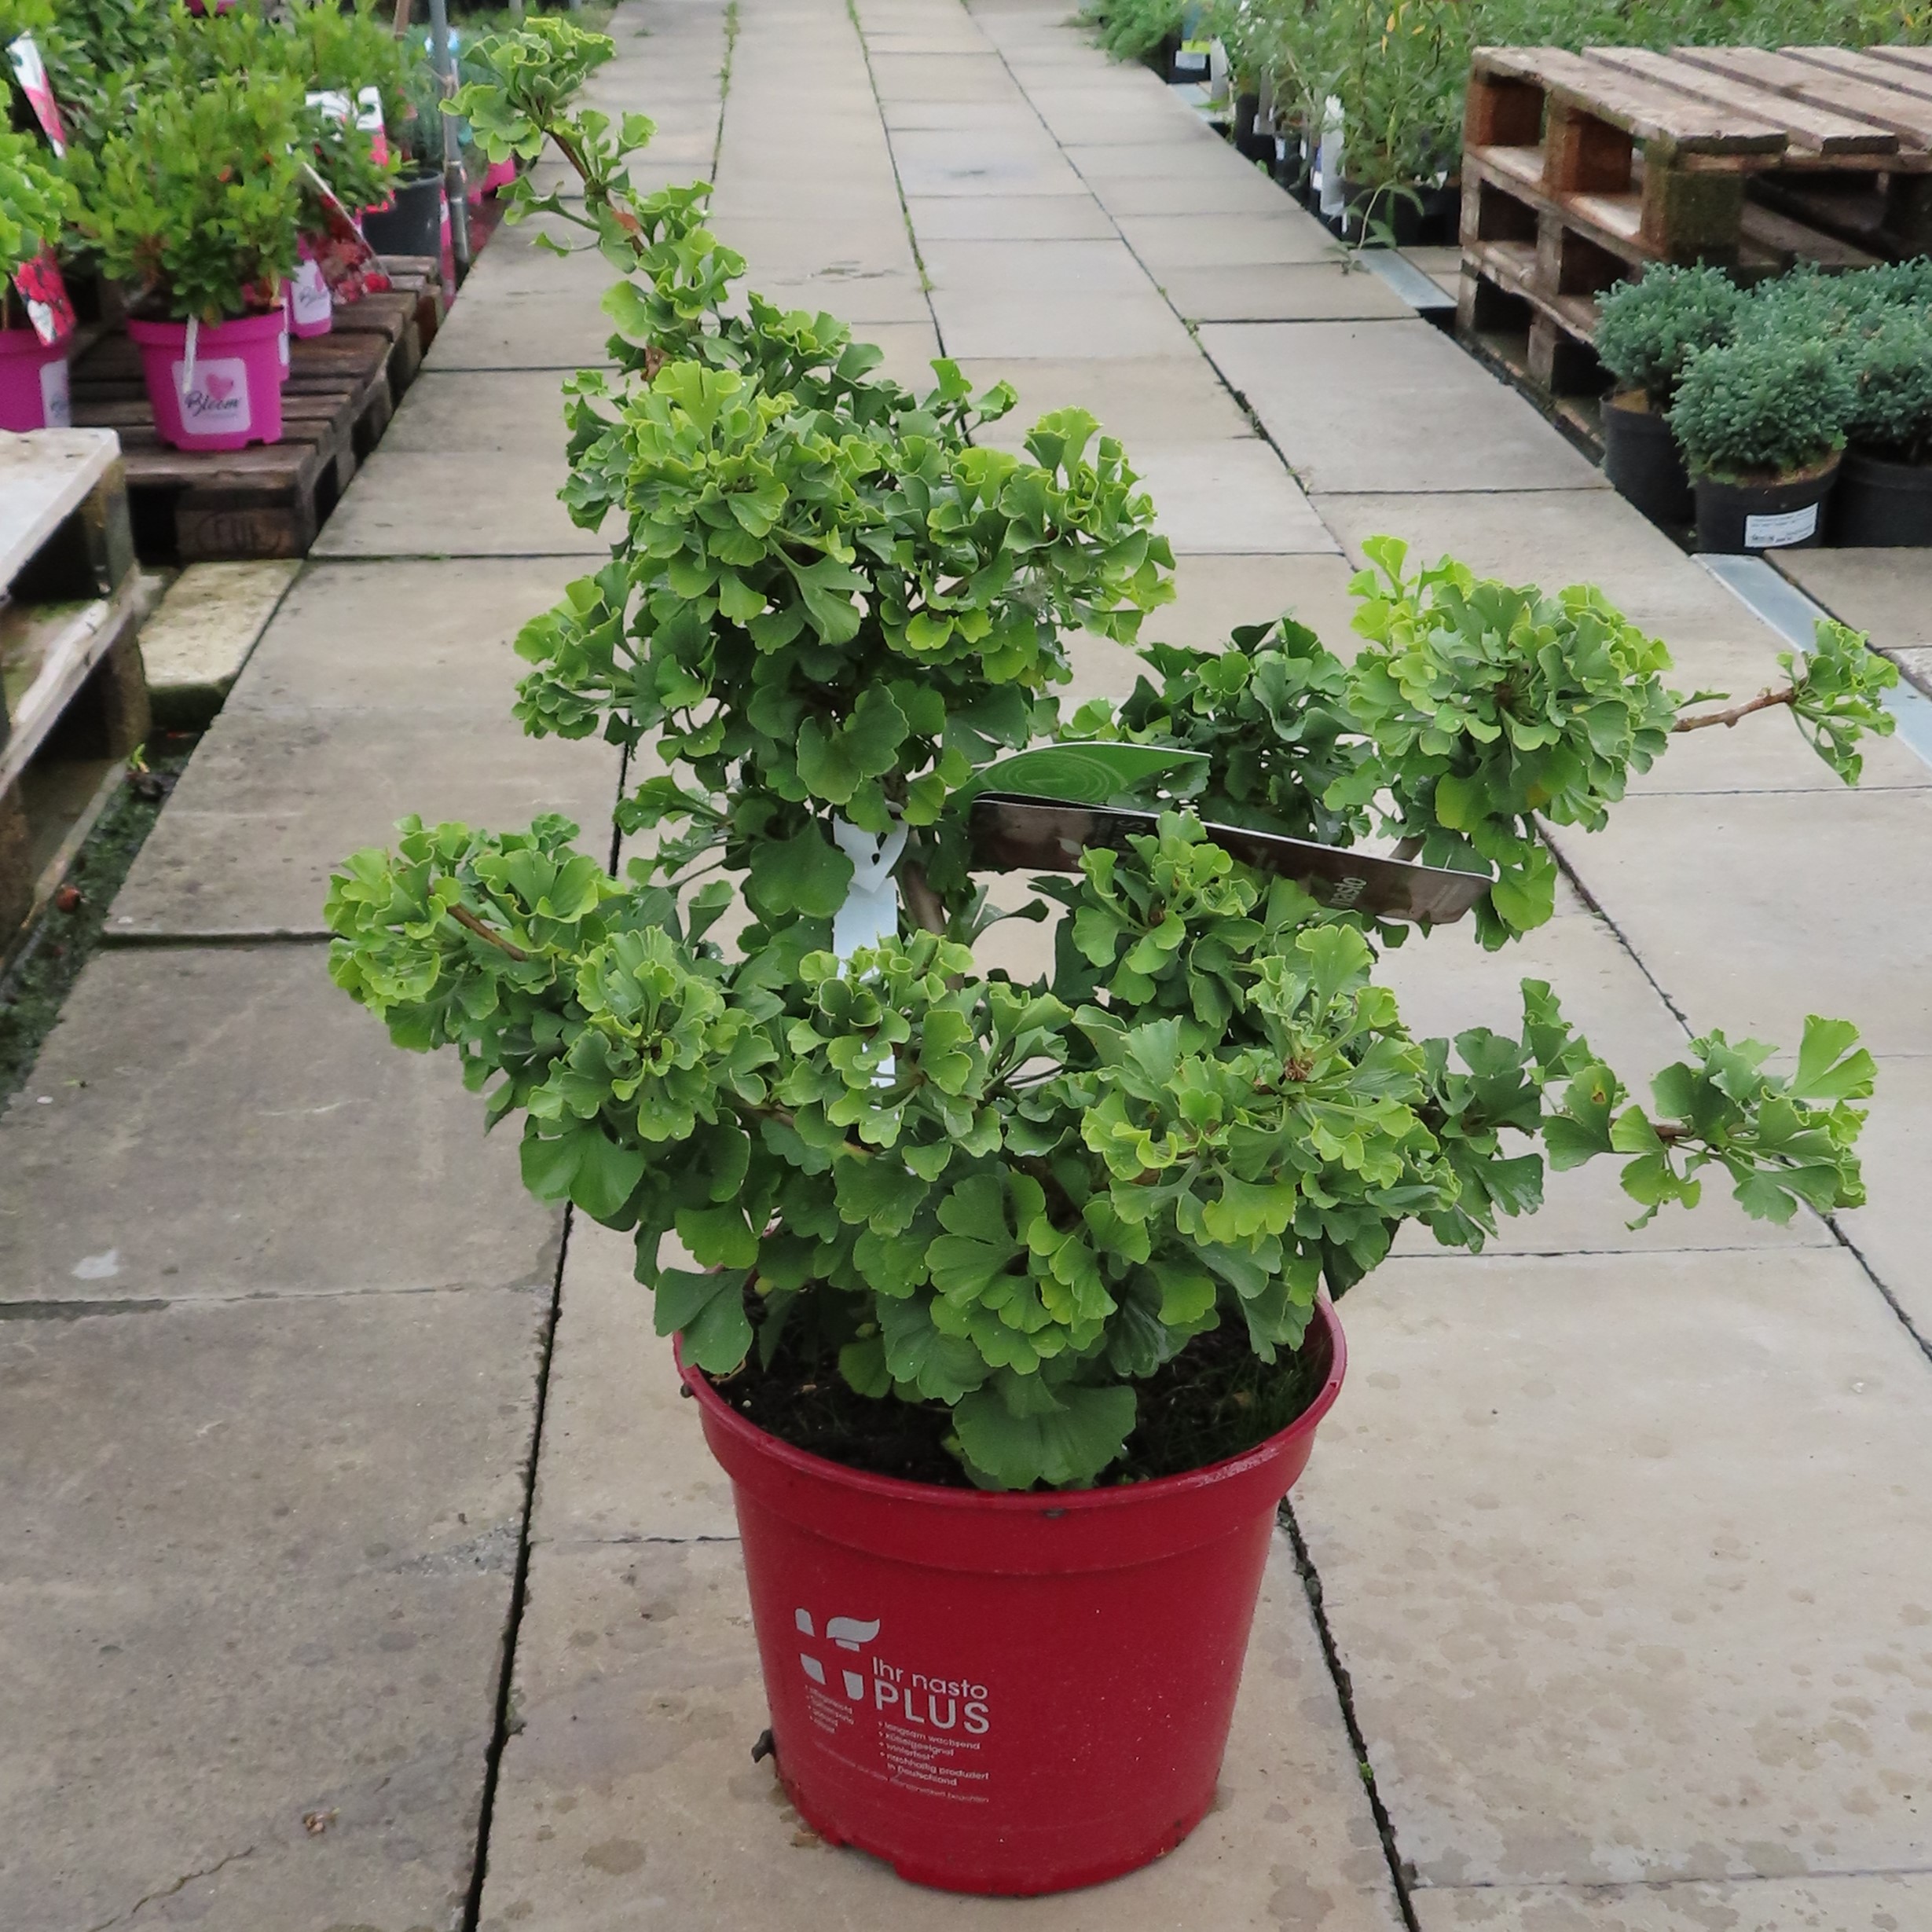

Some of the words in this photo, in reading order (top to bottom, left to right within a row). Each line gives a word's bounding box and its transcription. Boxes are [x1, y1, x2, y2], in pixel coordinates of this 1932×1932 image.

[872, 1656, 904, 1682] Ihr
[912, 1673, 988, 1700] nasto
[874, 1678, 990, 1734] PLUS
[928, 1735, 981, 1750] wachsend
[897, 1765, 958, 1786] Deutschland
[939, 1767, 989, 1780] produziert
